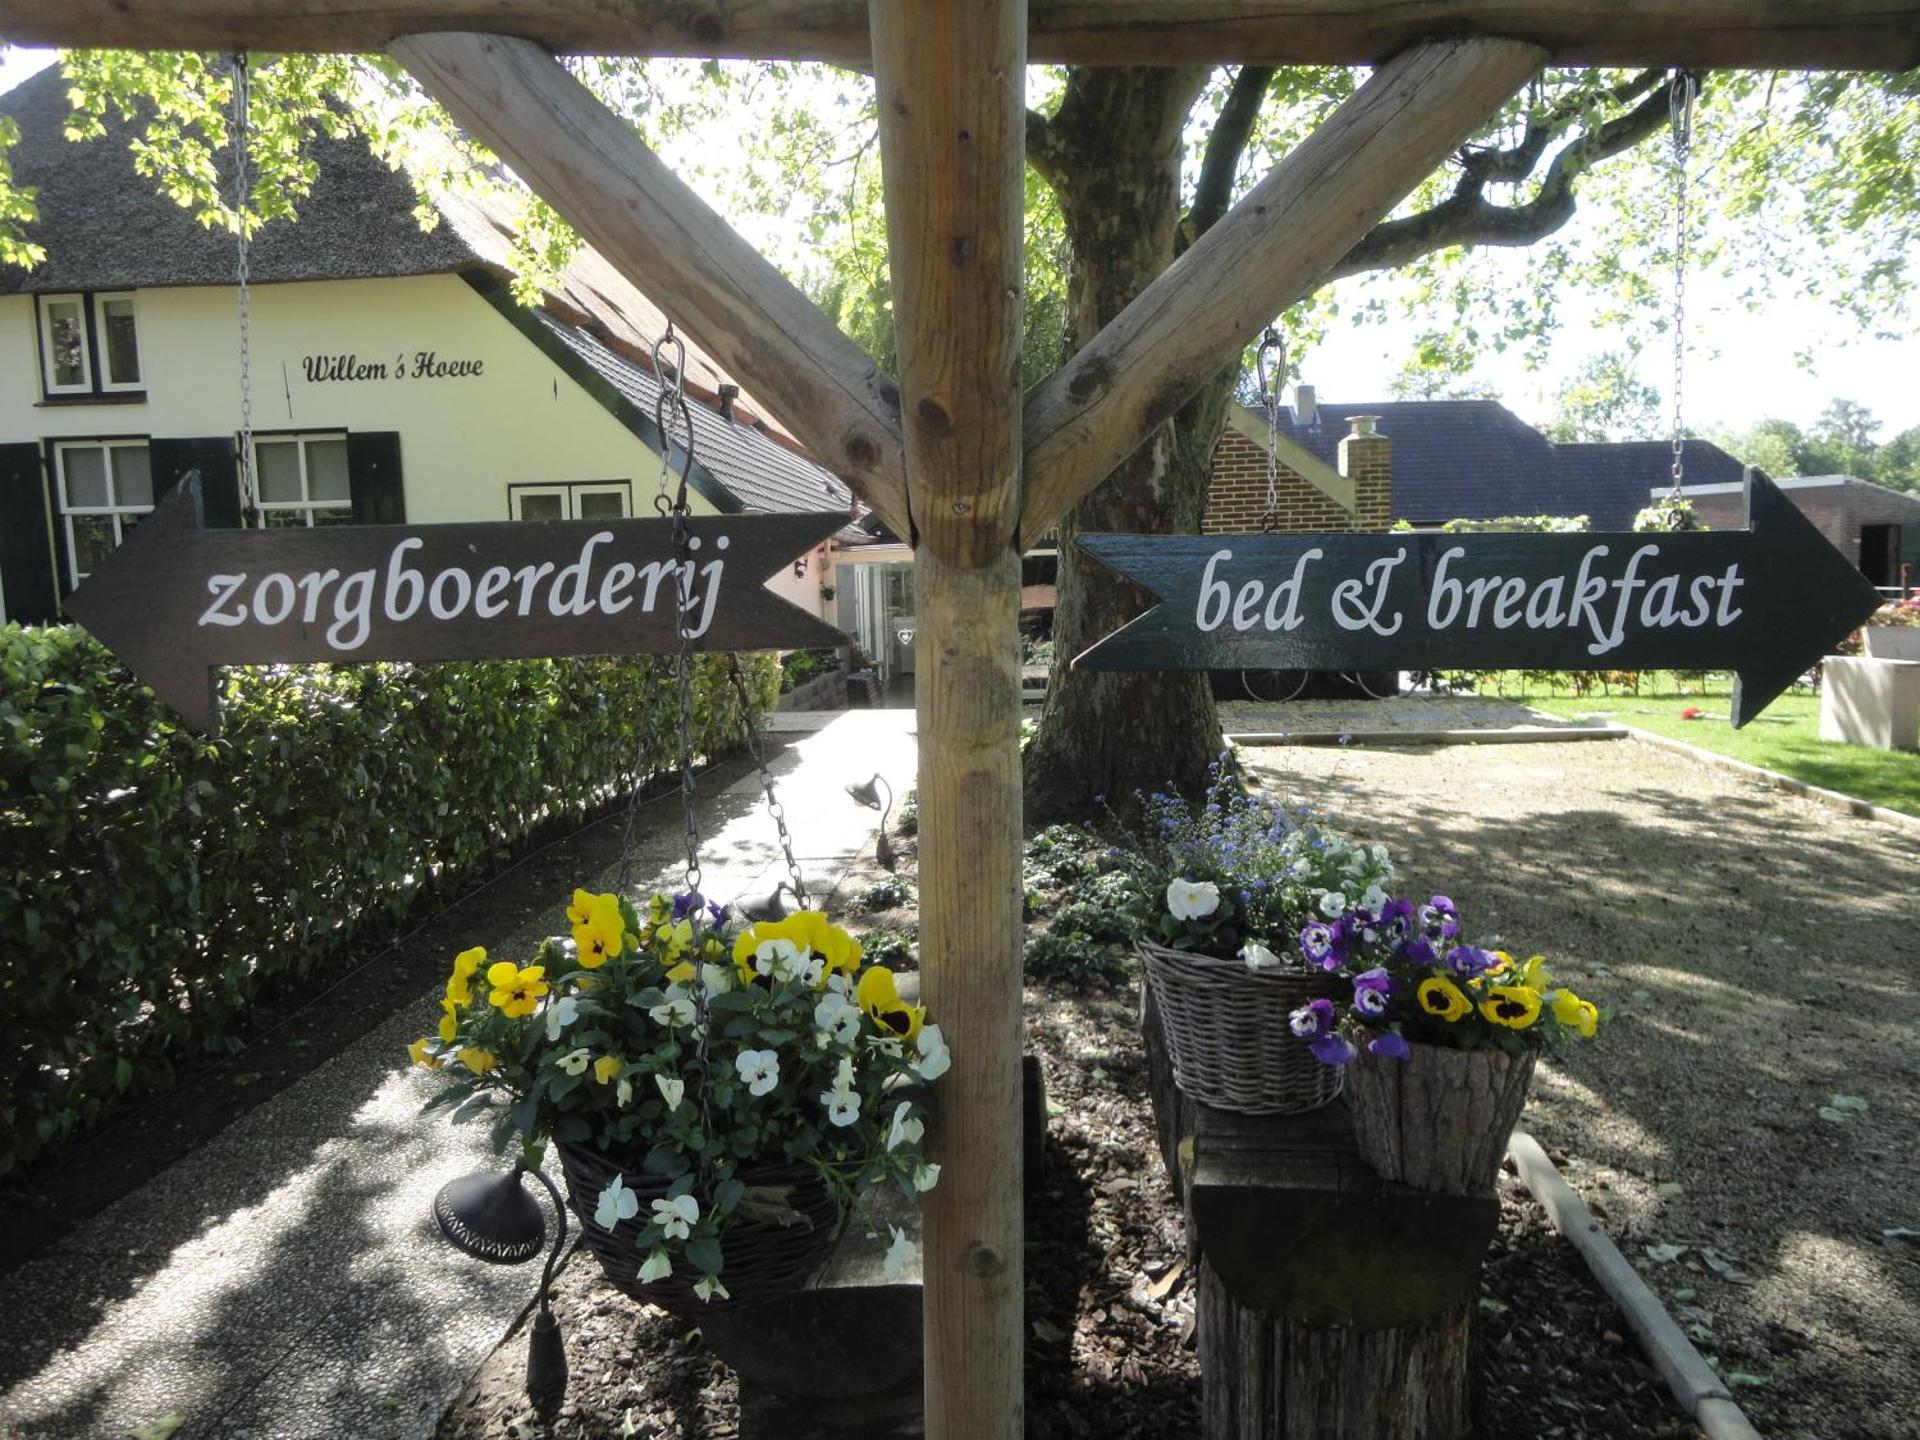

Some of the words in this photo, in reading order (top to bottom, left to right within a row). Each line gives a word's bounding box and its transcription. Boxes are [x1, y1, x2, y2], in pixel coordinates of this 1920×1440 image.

[412, 352, 483, 379] Hoeve
[198, 531, 730, 650] zorgboerderij
[1196, 547, 1323, 632] bed
[1331, 547, 1406, 636] &
[1427, 544, 1745, 655] breakfast
